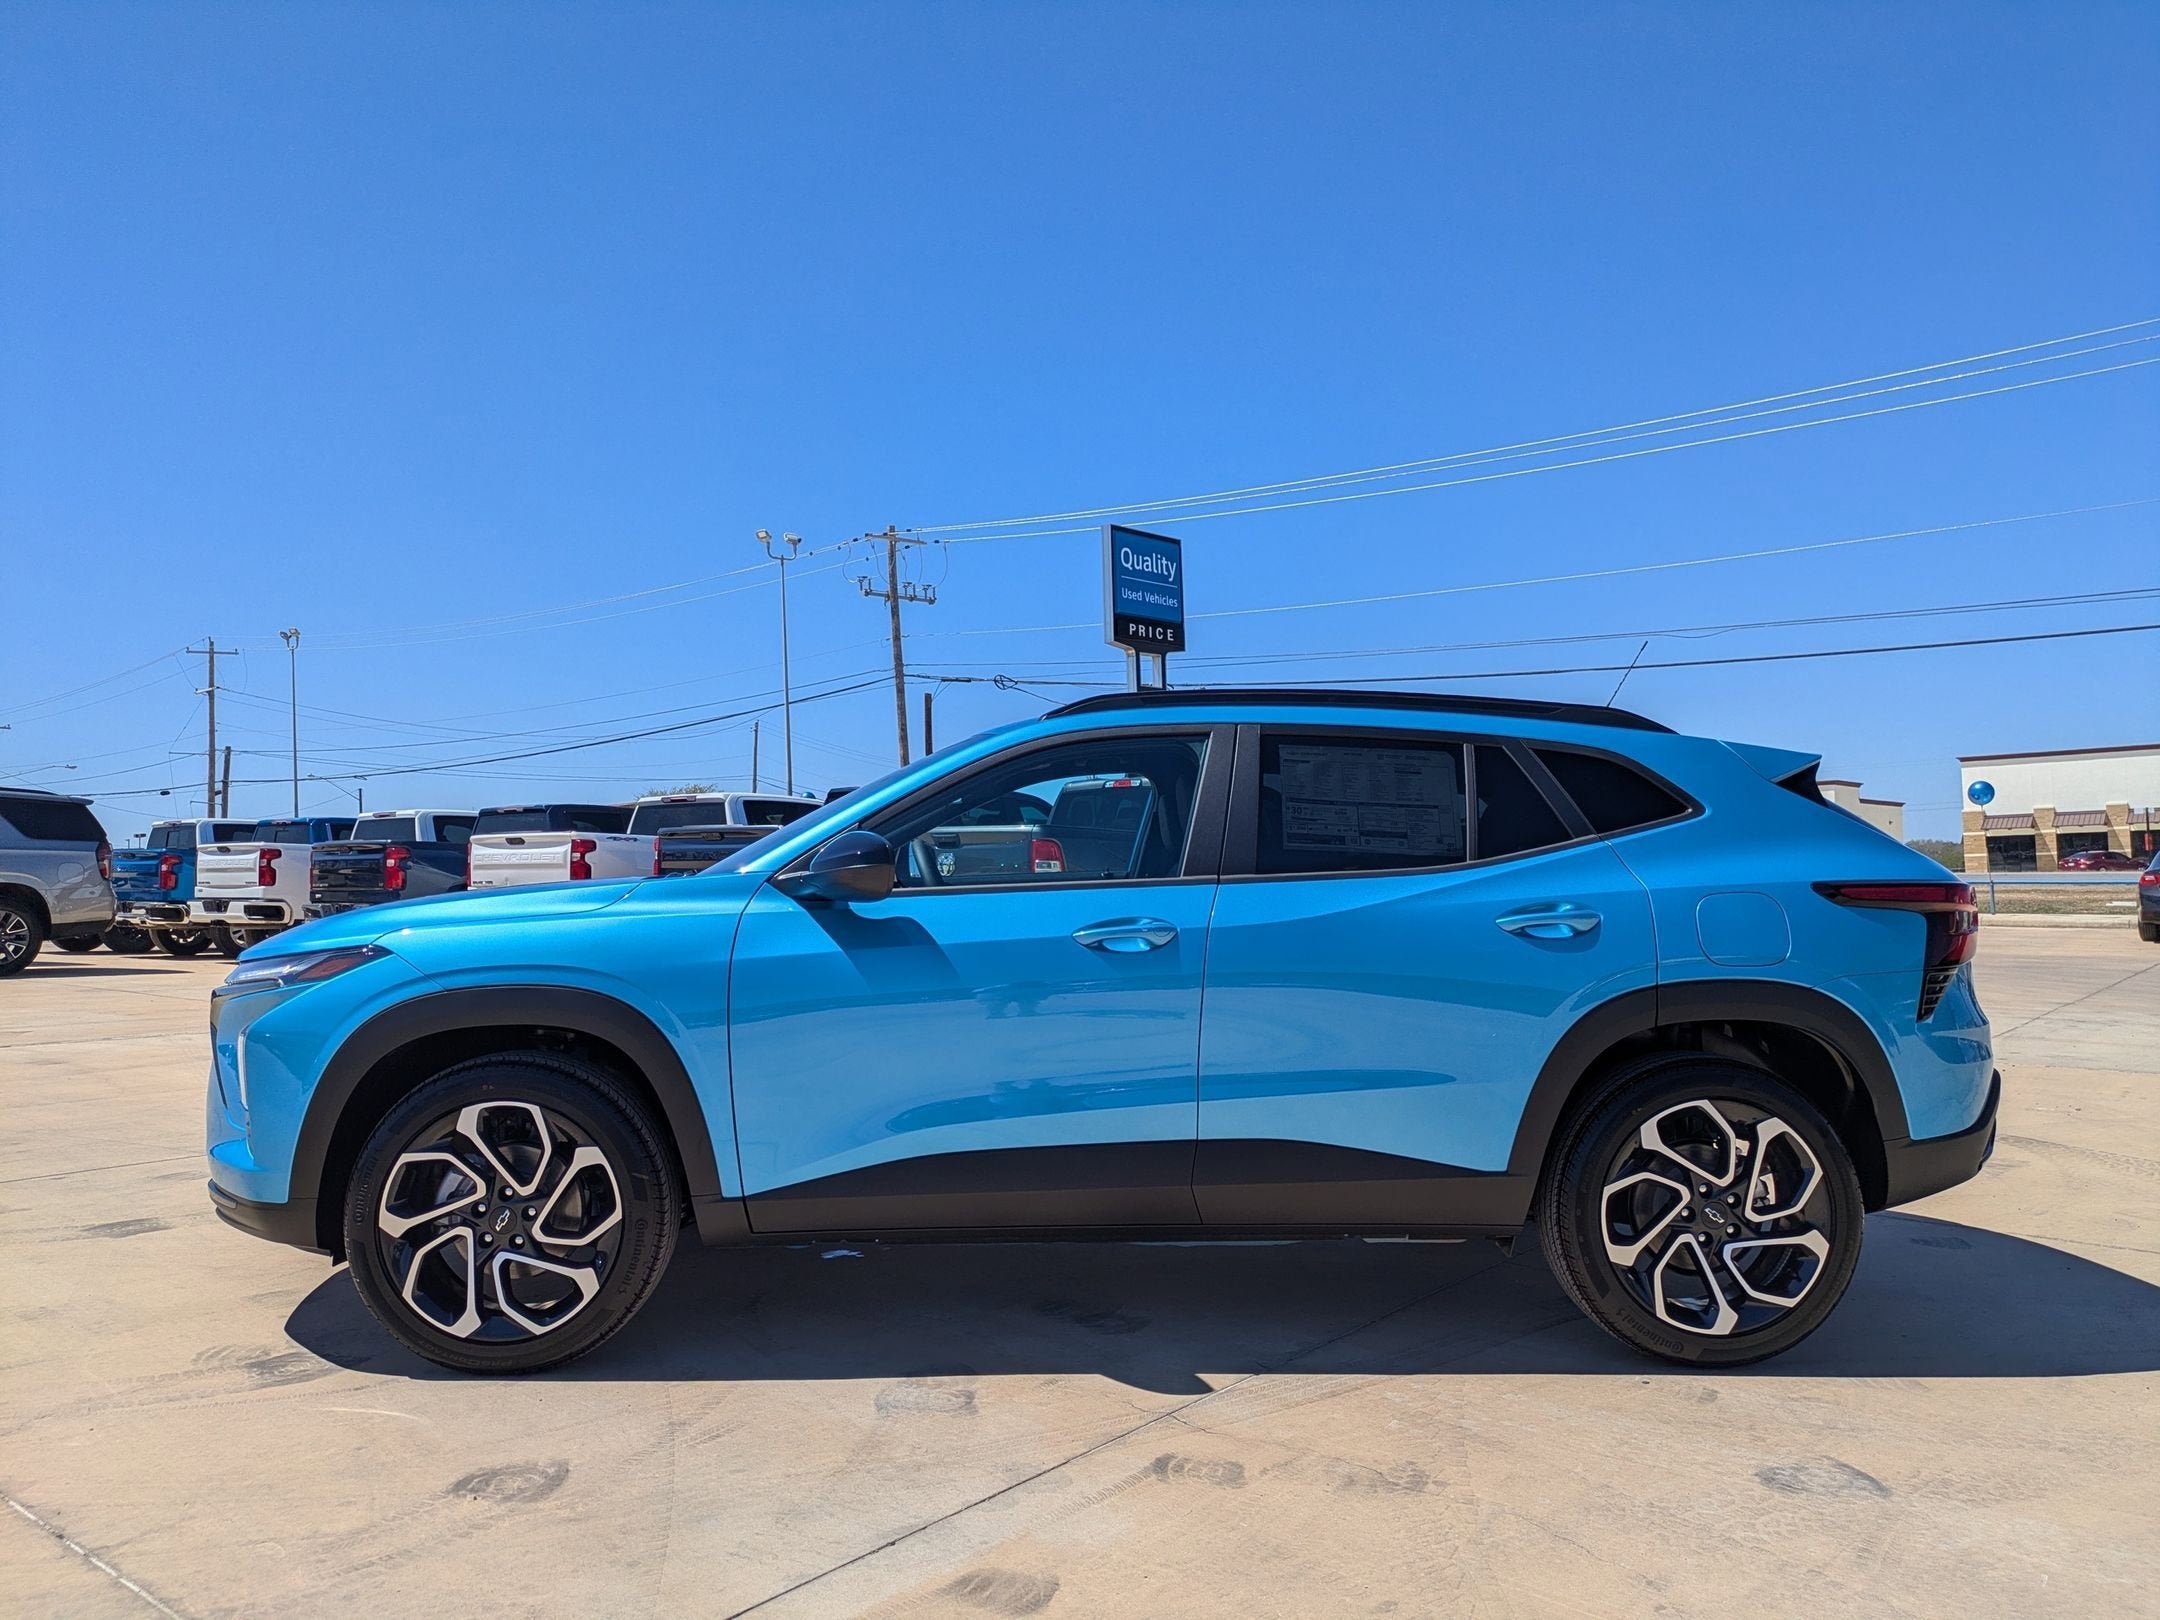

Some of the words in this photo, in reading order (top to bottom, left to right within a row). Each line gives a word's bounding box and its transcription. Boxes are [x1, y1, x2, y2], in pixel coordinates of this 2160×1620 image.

[1121, 547, 1176, 581] Quality
[1121, 587, 1142, 601] Used
[1145, 592, 1178, 607] Vehicles
[1129, 623, 1175, 641] PRICE
[622, 1217, 649, 1286] Continental
[1622, 1314, 1684, 1353] Continental
